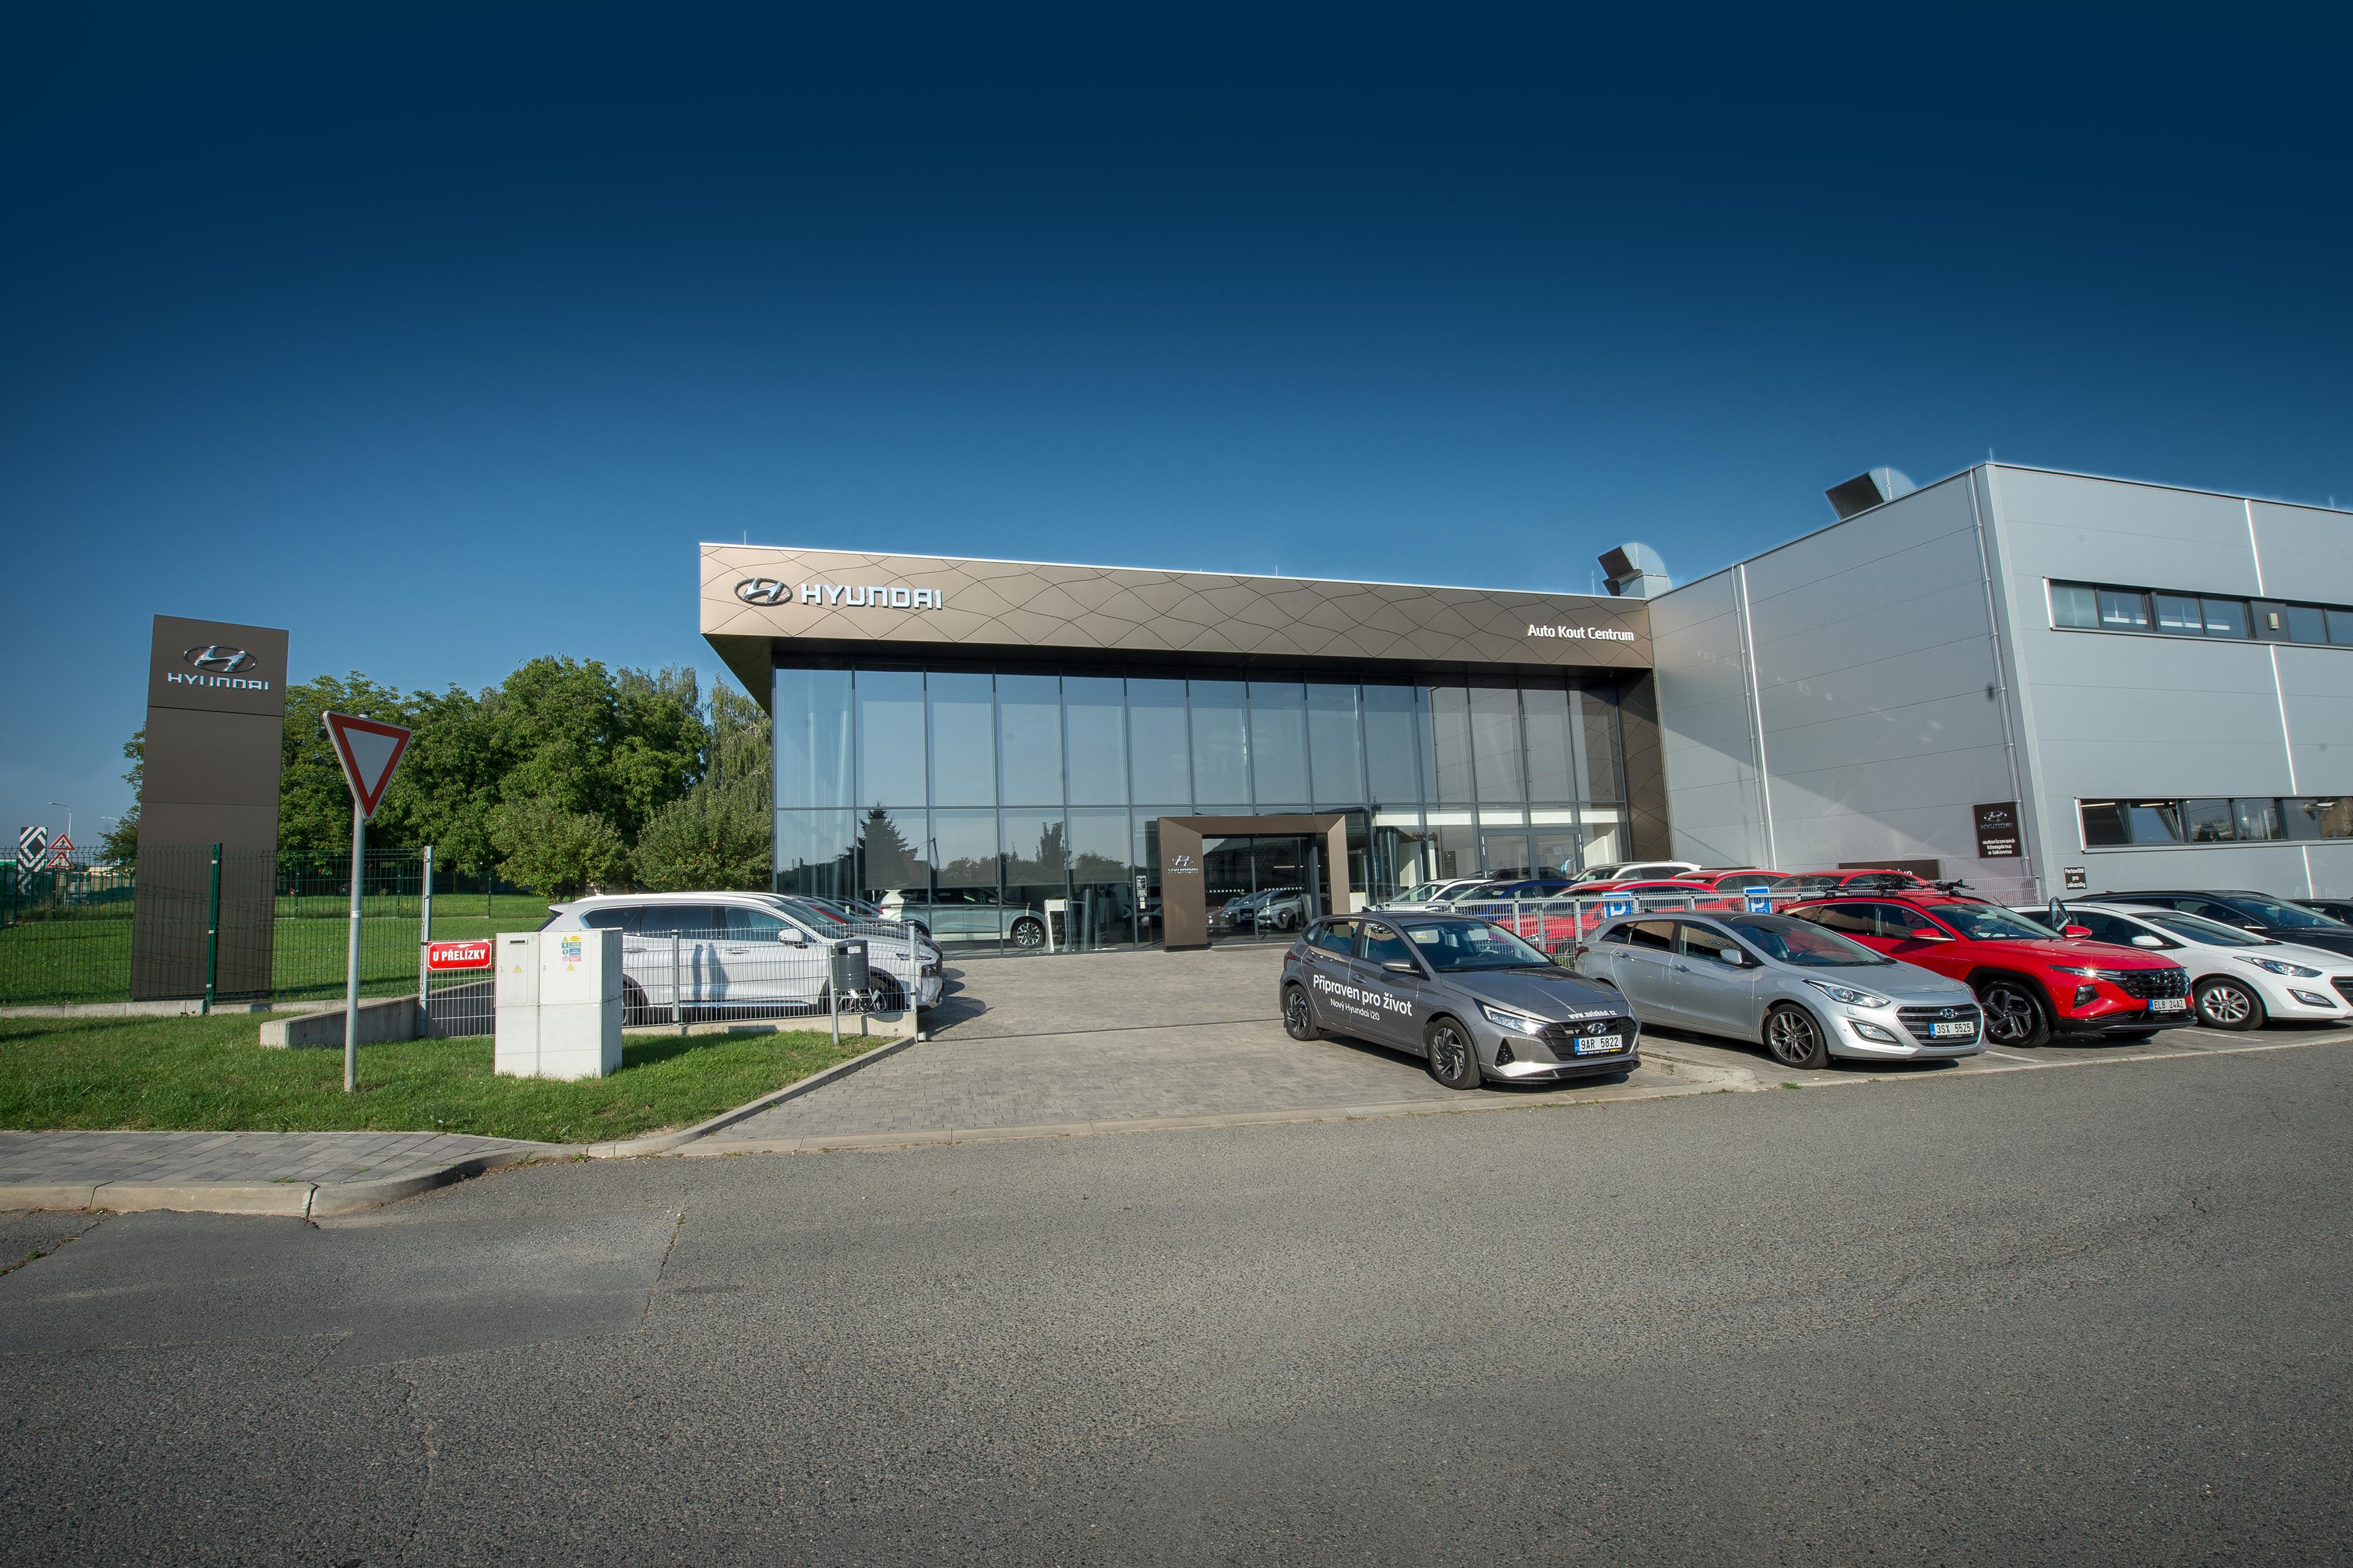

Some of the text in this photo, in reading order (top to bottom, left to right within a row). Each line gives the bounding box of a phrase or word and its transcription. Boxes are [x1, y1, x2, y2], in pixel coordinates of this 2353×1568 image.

[801, 583, 942, 610] HYUNDAI
[1528, 624, 1635, 641] Auto Kout Centrum
[168, 672, 269, 692] HYUNDAI
[433, 948, 486, 962] U PŘELÍZKY
[1314, 974, 1412, 1017] Připraven pro život
[1330, 998, 1380, 1021] Nový Hyundai i20
[2154, 1000, 2165, 1009] EL8
[2169, 1000, 2184, 1008] 24AZ
[1568, 1010, 1617, 1020] www.autokoutcz
[1937, 1025, 1951, 1034] 3SX
[1955, 1023, 1971, 1033] 5525
[1581, 1037, 1618, 1049] 9AR 5822
